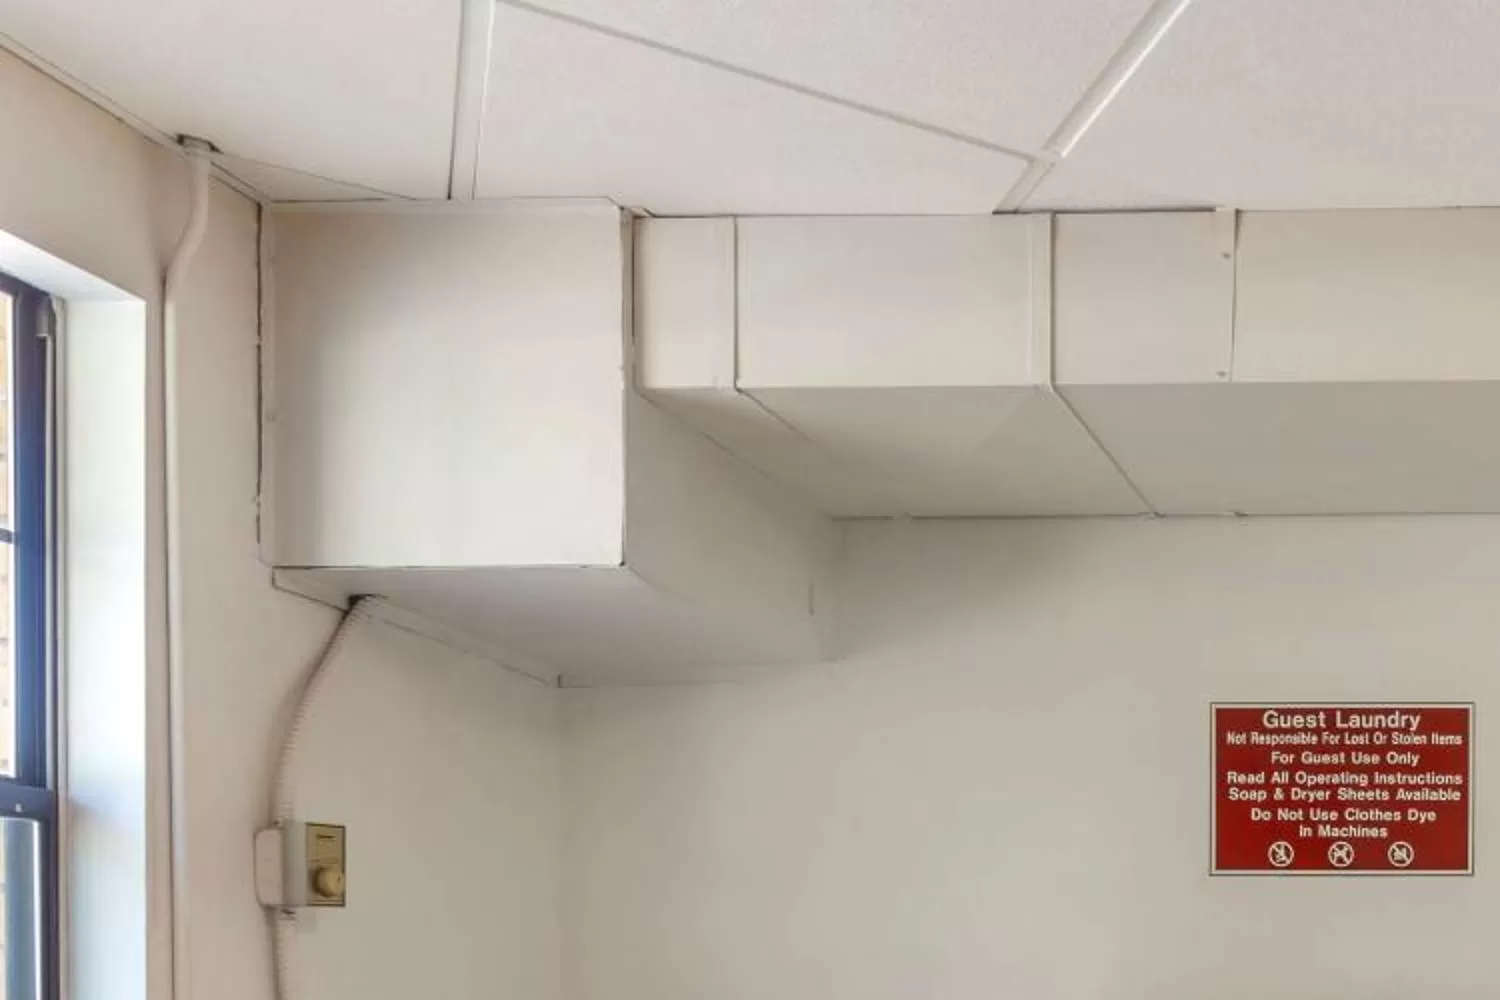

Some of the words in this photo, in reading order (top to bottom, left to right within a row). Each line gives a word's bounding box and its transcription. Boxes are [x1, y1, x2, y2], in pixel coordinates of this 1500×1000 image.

[1262, 710, 1326, 729] Guest
[1336, 710, 1421, 731] Laundry
[1227, 731, 1246, 745] Not
[1250, 731, 1318, 747] Responsible
[1322, 731, 1340, 745] For
[1344, 732, 1370, 745] Lost
[1373, 731, 1387, 745] Or
[1391, 731, 1427, 745] Stolen
[1431, 732, 1463, 745] Items
[1271, 751, 1295, 764] For
[1301, 751, 1345, 764] Guest
[1351, 751, 1380, 764] Use
[1386, 751, 1420, 767] Only
[1227, 771, 1265, 784] Read
[1271, 771, 1289, 784] All
[1295, 771, 1369, 787] Operating
[1374, 771, 1463, 785] Instructions
[1228, 787, 1267, 803] Soap
[1273, 787, 1285, 801] &
[1291, 788, 1331, 803] Dryer
[1337, 787, 1390, 801] Sheets
[1396, 787, 1461, 801] Available
[1251, 808, 1272, 821] Do
[1277, 808, 1304, 821] Not
[1310, 808, 1338, 821] Use
[1344, 808, 1402, 821] Clothes
[1407, 808, 1436, 824] Dye
[1299, 824, 1313, 837] In
[1318, 824, 1388, 838] Machines
